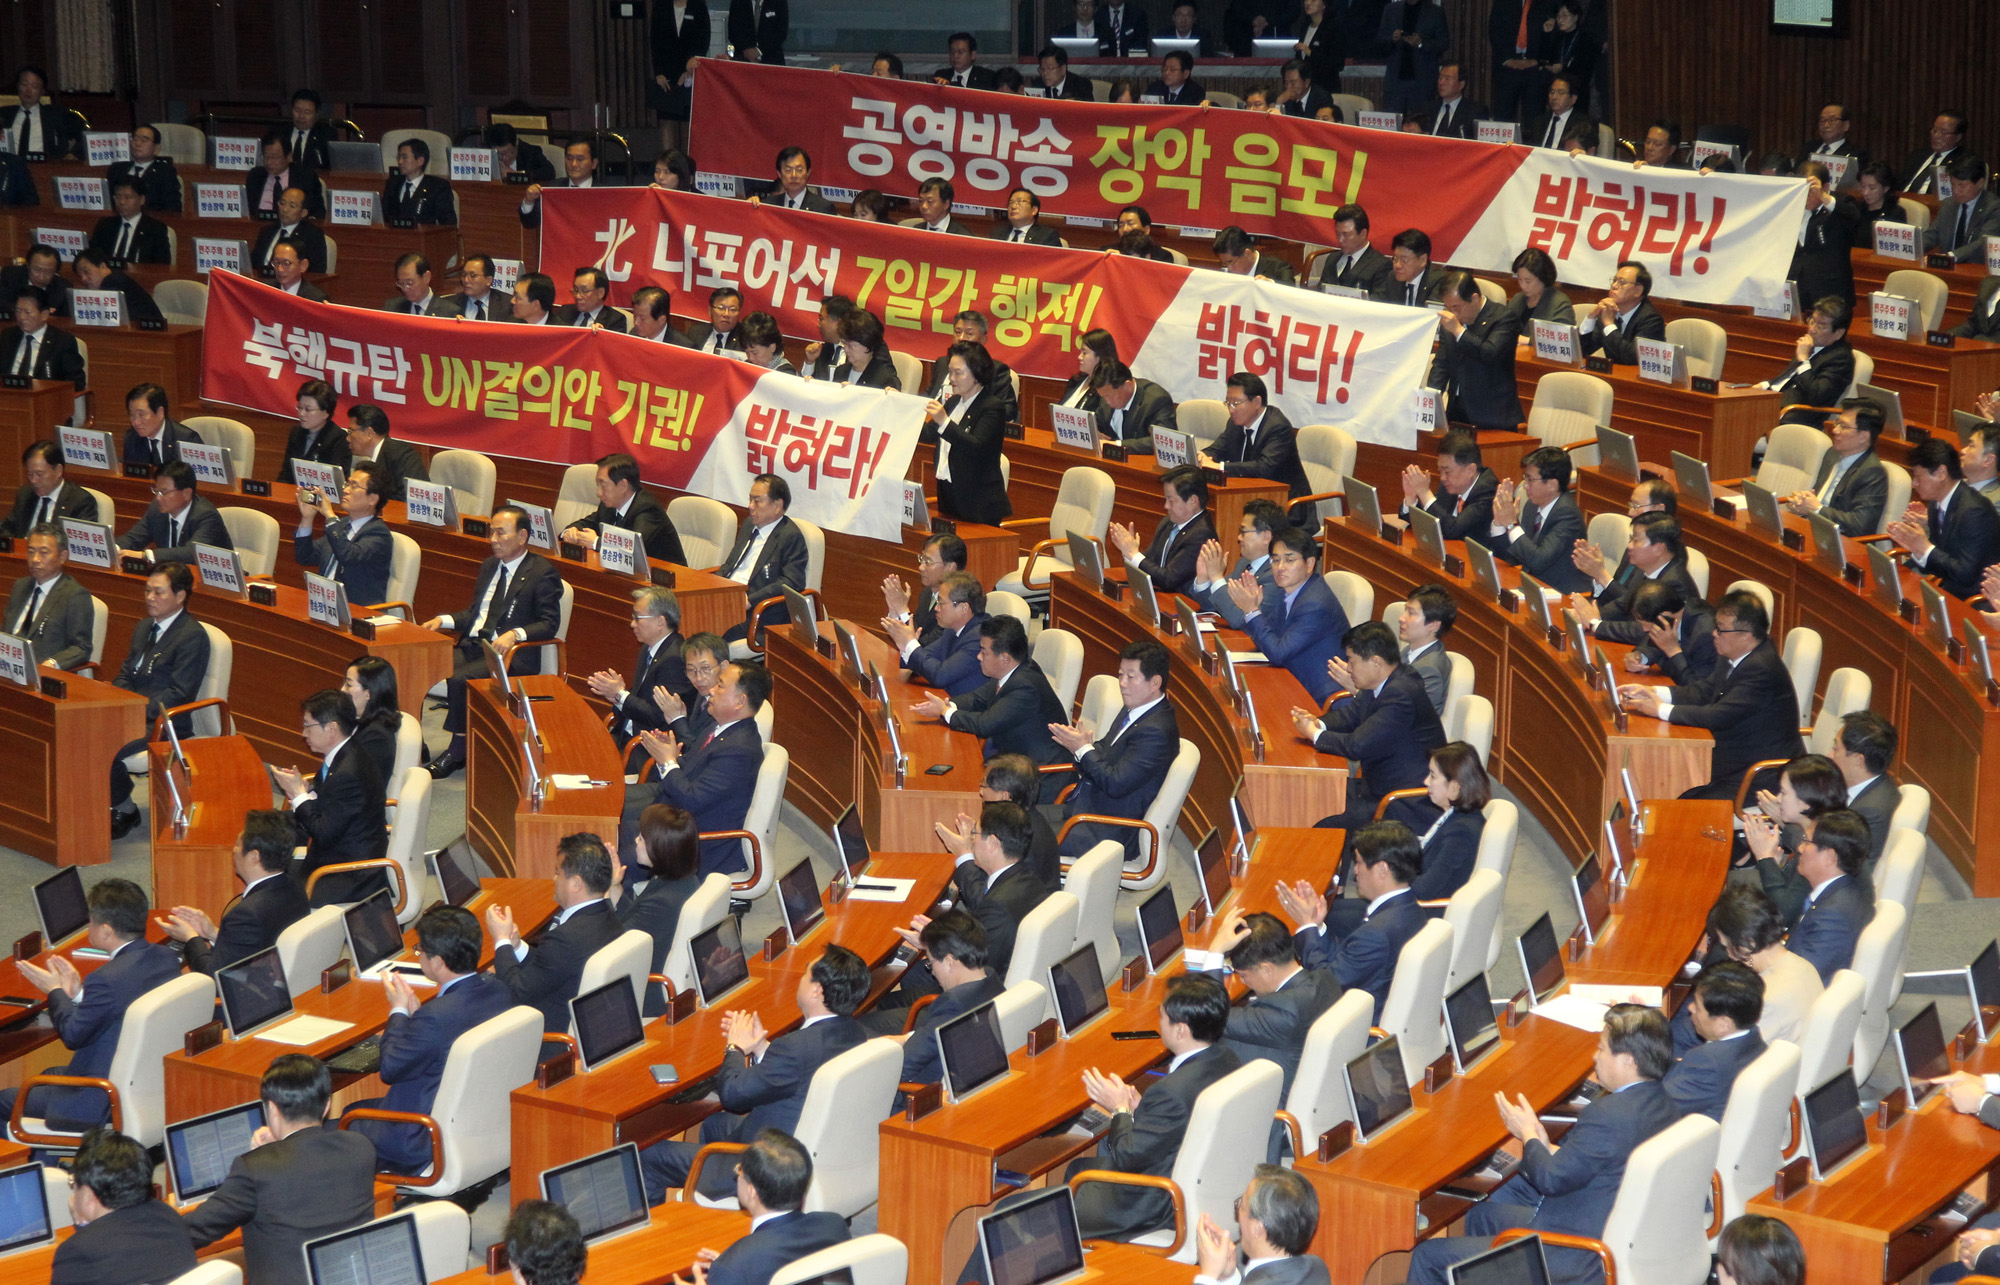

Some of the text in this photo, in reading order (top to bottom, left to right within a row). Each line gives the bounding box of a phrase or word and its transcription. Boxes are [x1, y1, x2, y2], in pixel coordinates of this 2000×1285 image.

[1361, 117, 1394, 127] 민주주의 유린
[1480, 127, 1512, 138] 민주주의 유린
[90, 138, 127, 149] 민주주의 유린
[218, 143, 255, 153] 민주주의 유린
[92, 150, 128, 160] 방송장악 저지
[218, 155, 255, 165] 방송장악 저지
[453, 153, 489, 163] 민주주의 유린
[453, 166, 489, 175] 방송장악 저지
[1836, 162, 1846, 172] 유린
[61, 182, 100, 192] 민주주의 유린
[697, 181, 734, 192] 방송장악 저지
[843, 96, 1727, 277] 공영방송 장악 음모! 밝혀라!
[64, 194, 101, 204] 방송장악 저지
[200, 190, 239, 199] 민주주의 유린
[335, 196, 371, 206] 민주주의 유린
[201, 202, 239, 212] 방송장악 저지
[334, 208, 371, 219] 방송장악 저지
[40, 234, 80, 245] 민주주의 유린
[1877, 226, 1912, 240] 민주주의 유린
[199, 246, 237, 257] 민주주의 유린
[1879, 240, 1913, 254] 방송장악 저지
[226, 260, 238, 270] 저지
[506, 266, 517, 275] 유린
[76, 296, 116, 307] 민주주의 유린
[78, 310, 117, 320] 방송장악 저지
[594, 218, 1365, 405] 北 나포어선 7일간 행적! 밝혀라!
[1874, 303, 1908, 318] 민주주의 유린
[1874, 318, 1907, 332] 방송장악 저지
[1536, 327, 1568, 342] 민주주의 유린
[1538, 342, 1570, 356] 방송장악 저지
[1639, 345, 1672, 361] 민주주의 유린
[1642, 360, 1670, 376] 방송장악 저지
[1423, 396, 1433, 408] 유린
[243, 318, 891, 500] 북핵규탄 UN결의안 기권! 밝혀라!
[1055, 412, 1087, 428] 민주주의 유린
[1422, 413, 1433, 424] 저지
[1057, 427, 1090, 442] 방송장악 저지
[63, 433, 103, 450] 민주주의 유린
[1155, 433, 1185, 452] 민주주의 유린
[66, 447, 107, 463] 방송장악 저지
[182, 448, 220, 463] 민주주의 유린
[1158, 449, 1175, 462] 방송장악
[191, 464, 224, 478] 송장악 저지
[296, 466, 331, 483] 민주주의 유린
[324, 486, 337, 497] 저지
[409, 486, 443, 503] 민주주의 유린
[905, 490, 913, 502] 유린
[410, 503, 442, 520] 방송장악 저지
[904, 506, 912, 518] 저지
[534, 514, 544, 526] 유린
[66, 528, 104, 545] 민주주의 유린
[536, 530, 547, 541] 저지
[602, 532, 632, 551] 민주주의 유린
[70, 543, 108, 560] 방송장악 저지
[601, 548, 631, 568] 방송장악 저지
[198, 552, 232, 569] 민주주의 유린
[202, 568, 236, 585] 방송장악 저지
[309, 582, 336, 602] 민주주의 유린
[310, 599, 337, 619] 방송장악 저지
[12, 645, 22, 659] 유린
[13, 664, 24, 677] 저지
